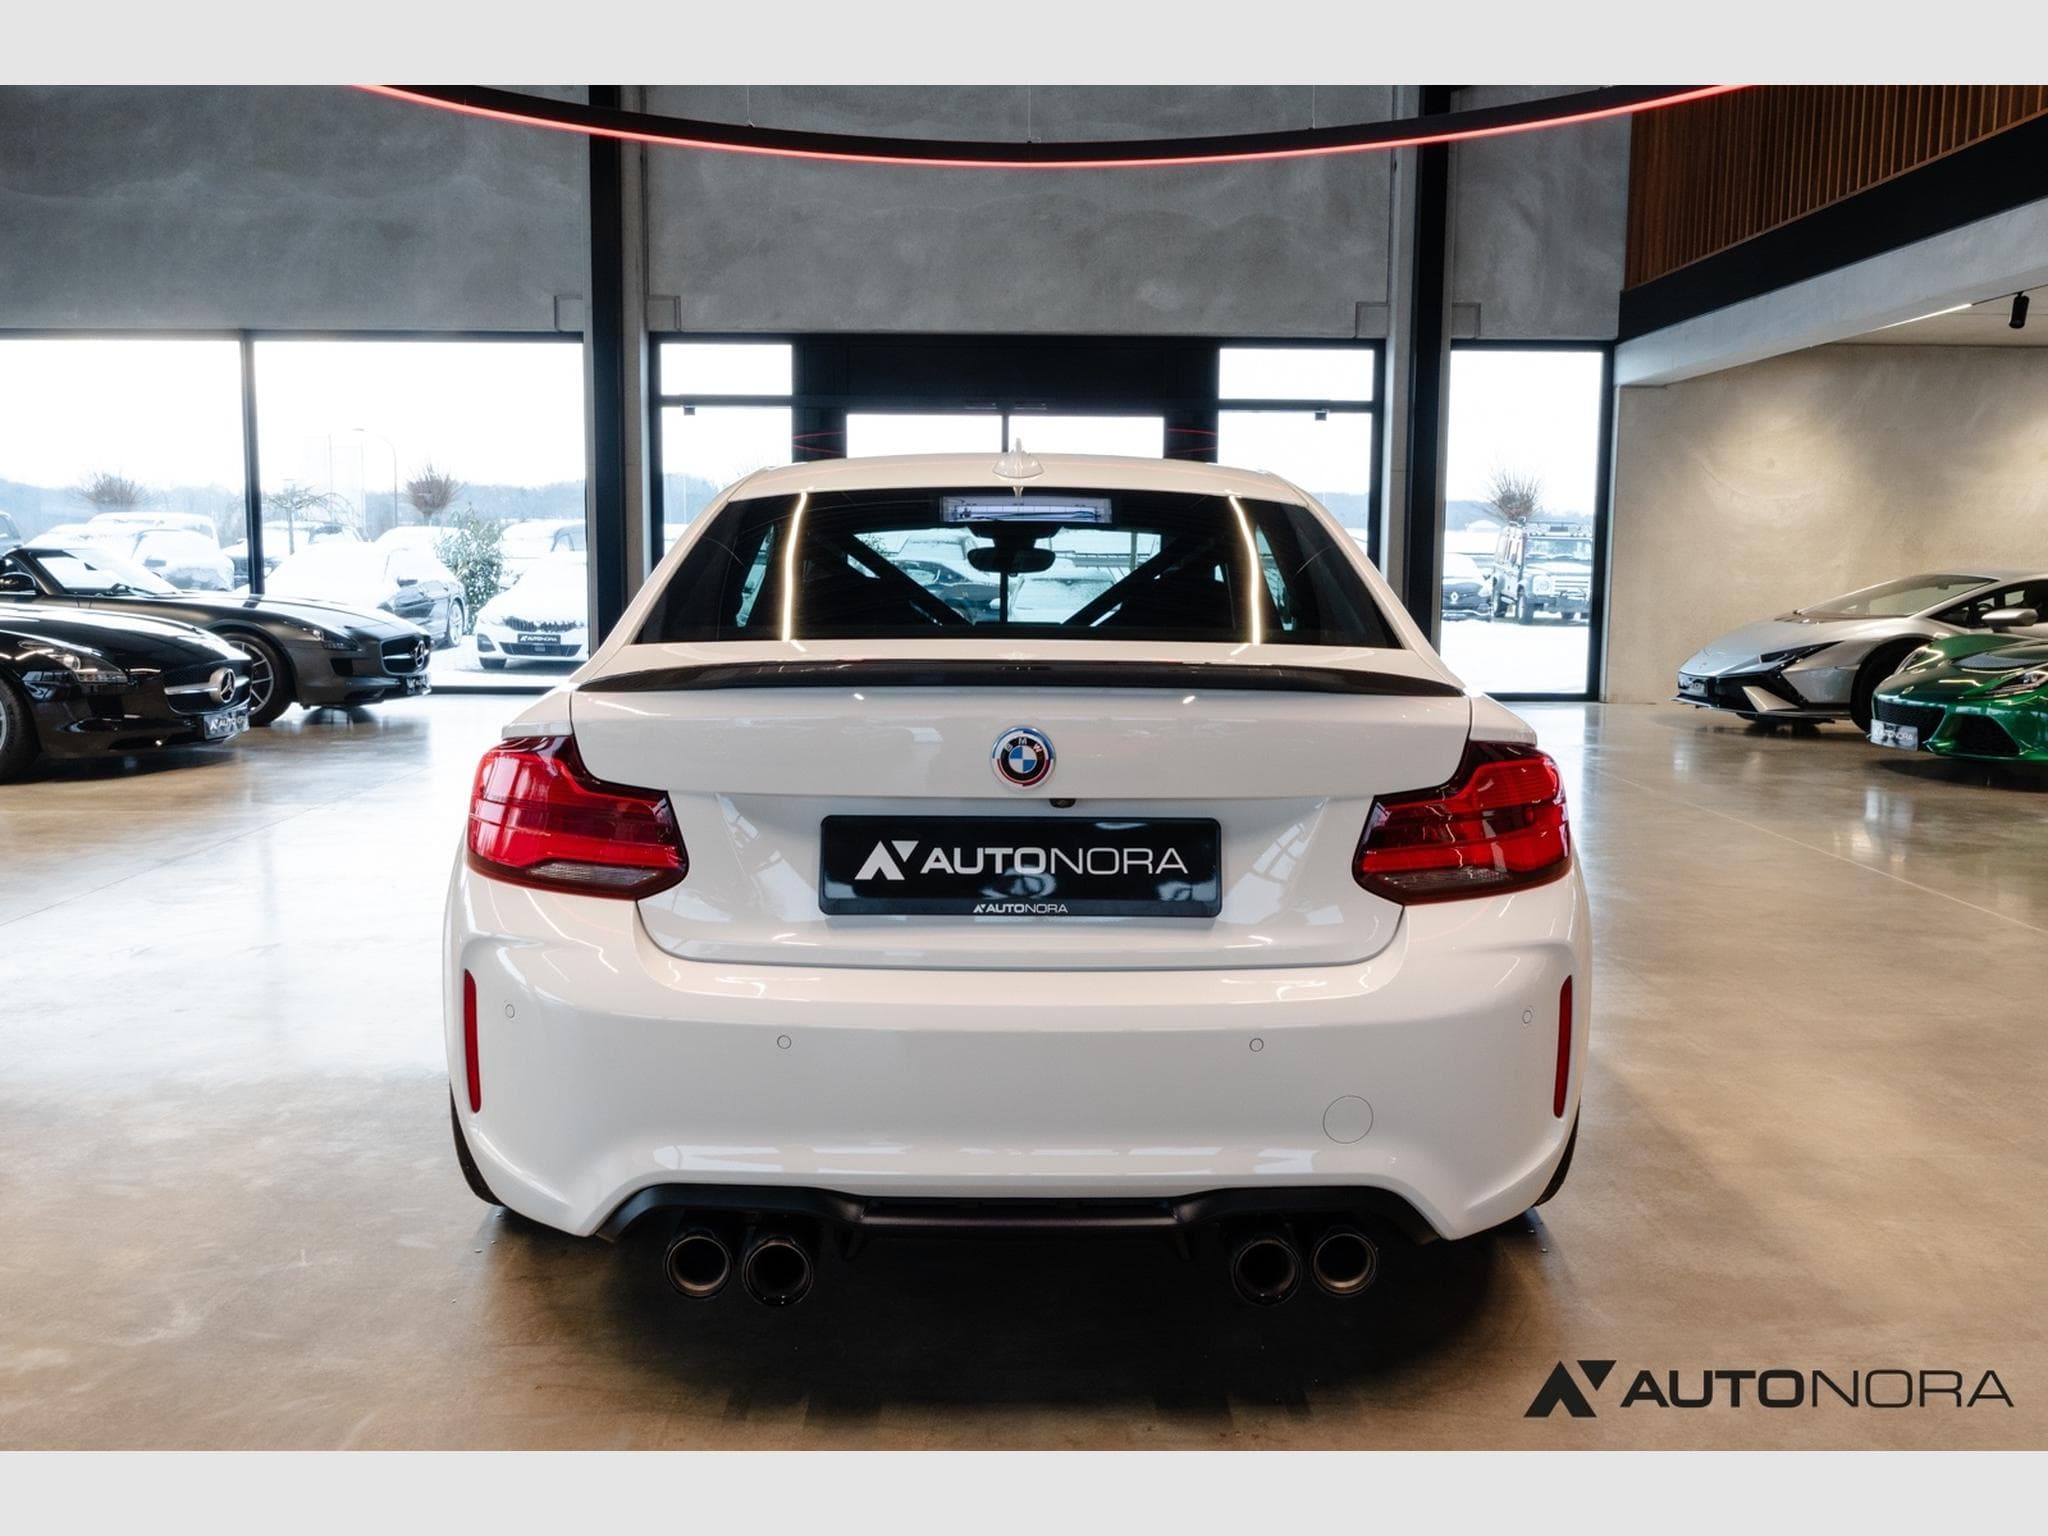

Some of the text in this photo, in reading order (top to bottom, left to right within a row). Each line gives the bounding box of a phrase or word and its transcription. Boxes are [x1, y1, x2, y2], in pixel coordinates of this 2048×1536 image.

[1004, 736, 1044, 753] BMW
[919, 846, 1189, 875] AUTONORA
[985, 903, 1068, 914] AUTONORA
